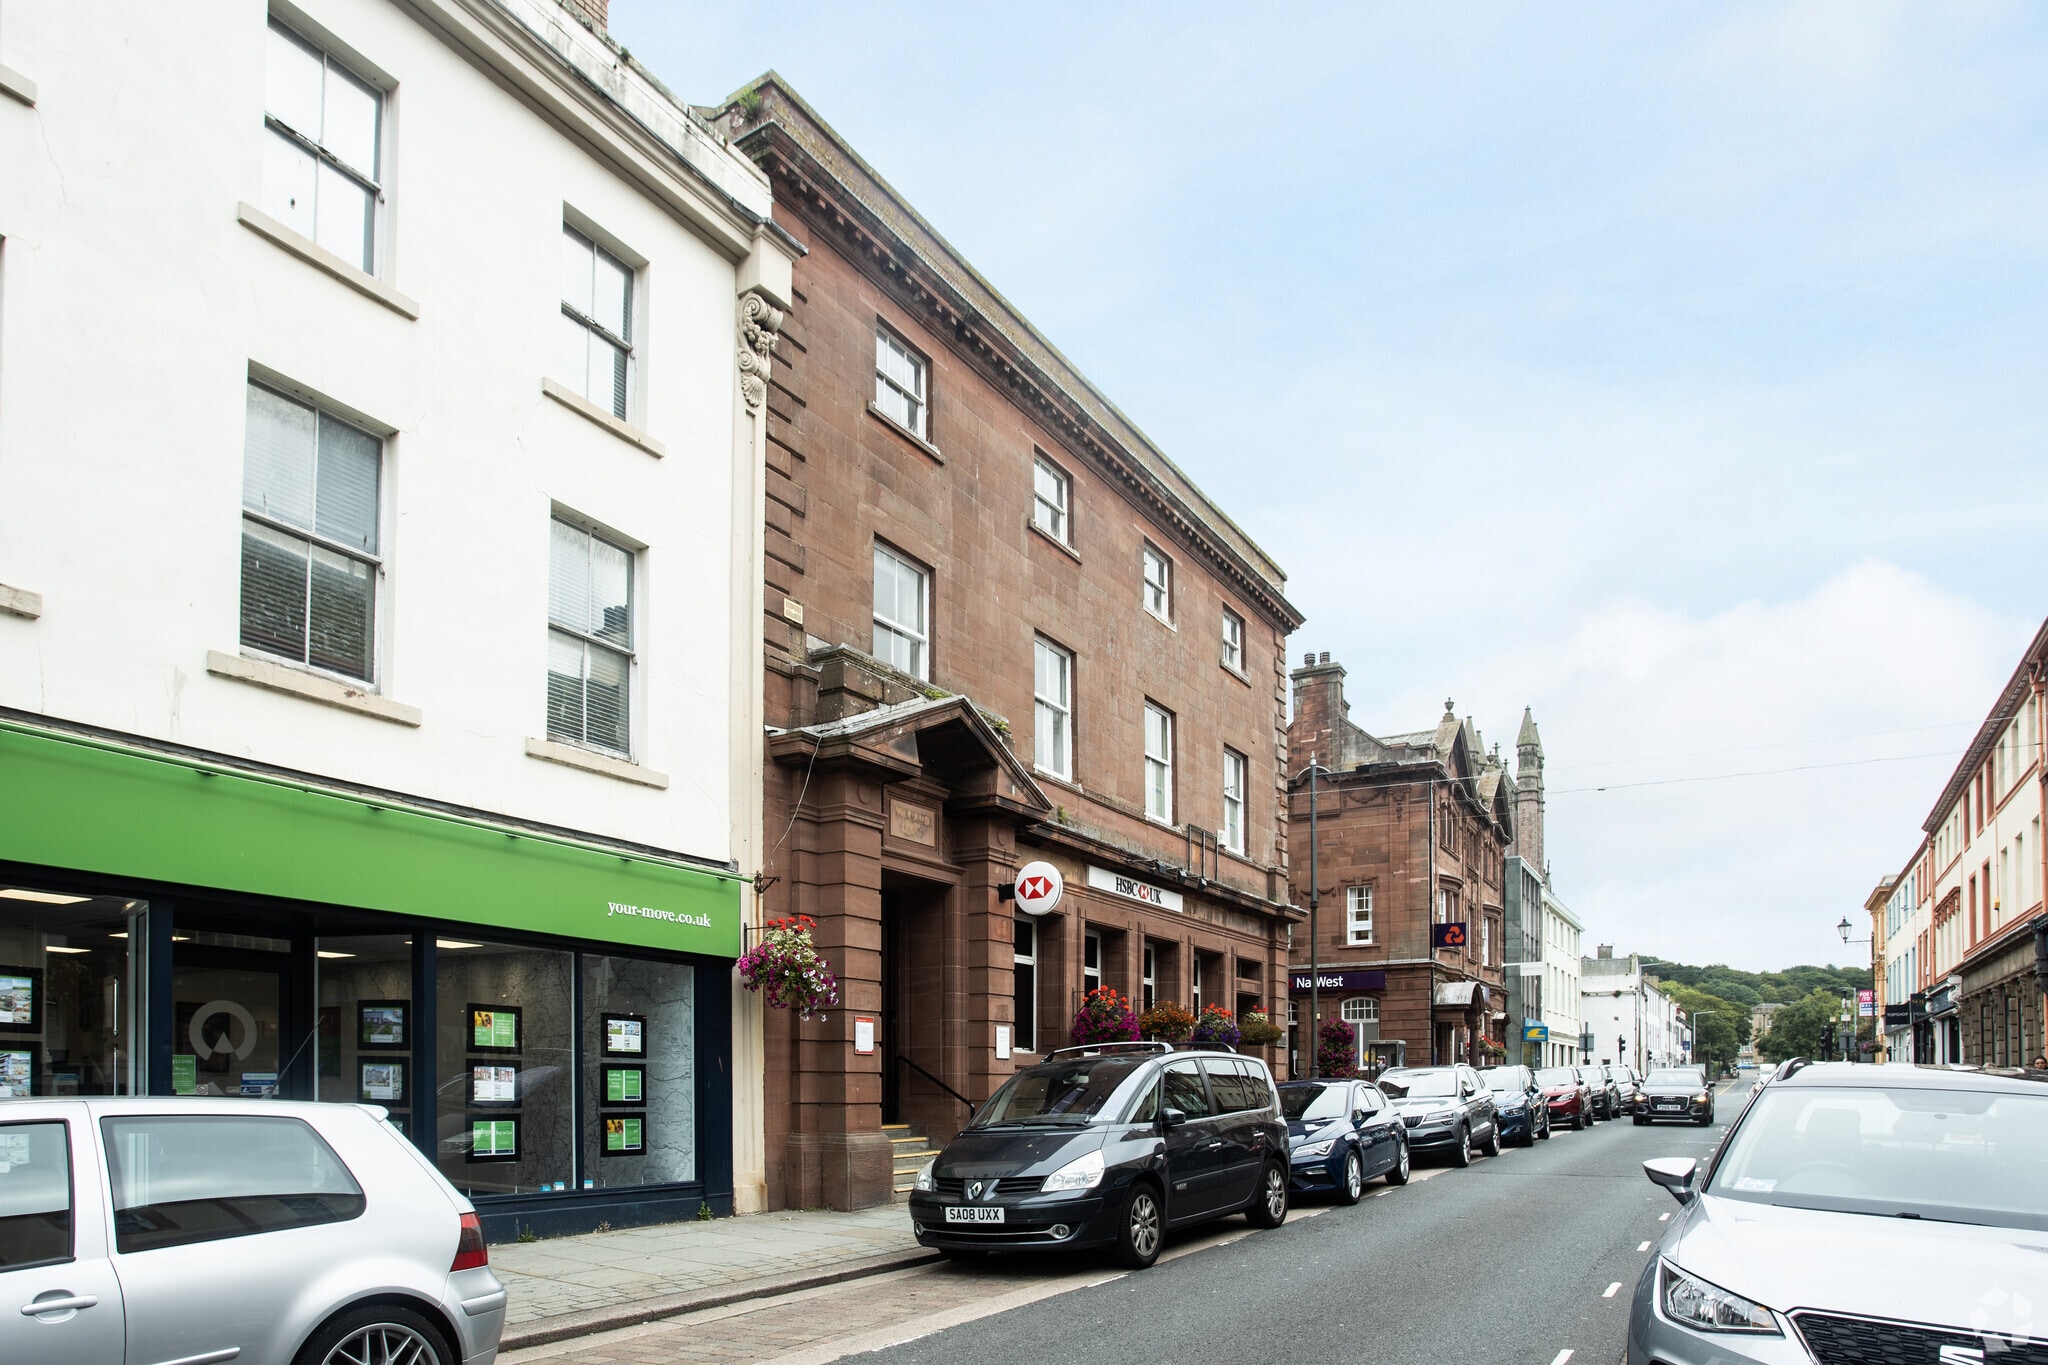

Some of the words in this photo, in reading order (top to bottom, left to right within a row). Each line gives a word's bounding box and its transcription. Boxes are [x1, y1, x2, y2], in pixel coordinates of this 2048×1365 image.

[1115, 877, 1138, 897] HSBC
[1149, 887, 1162, 904] UK
[607, 901, 711, 928] your-move.co.uk
[1296, 975, 1344, 988] NaWest
[949, 1208, 975, 1221] SA08
[978, 1208, 1000, 1221] UXX
